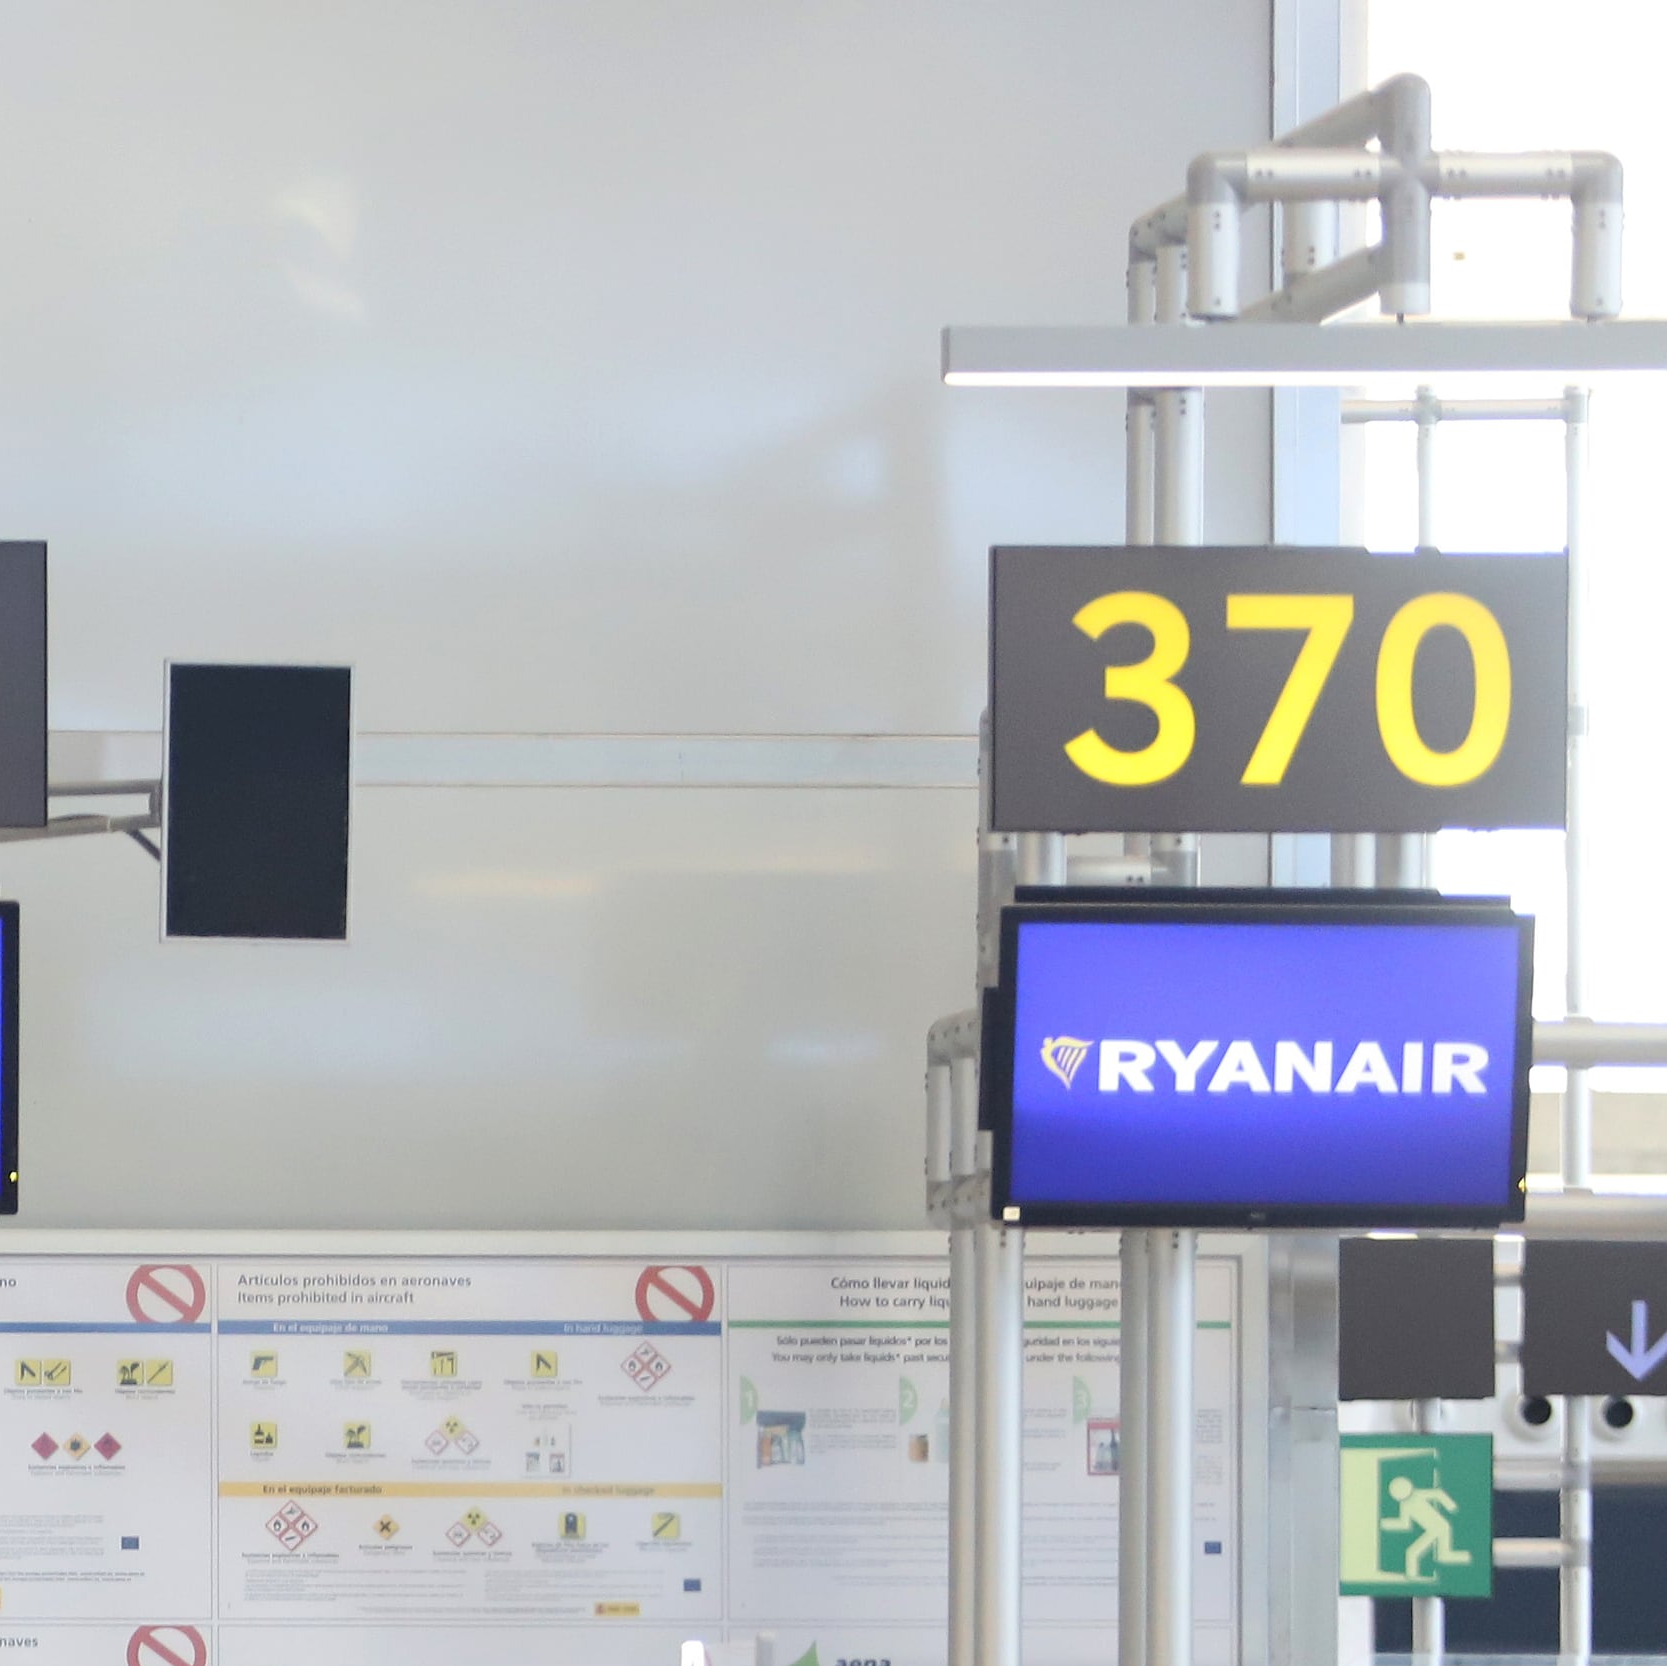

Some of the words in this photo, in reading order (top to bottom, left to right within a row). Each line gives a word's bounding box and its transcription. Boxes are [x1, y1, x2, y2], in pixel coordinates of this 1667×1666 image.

[1064, 591, 1512, 787] 370
[1099, 1040, 1489, 1093] RYANAIR
[303, 1274, 376, 1289] prohibidos
[381, 1277, 396, 1286] en
[402, 1278, 471, 1286] aeronaves
[238, 1292, 273, 1303] Items
[278, 1291, 346, 1306] prohibited
[351, 1292, 363, 1303] in
[368, 1291, 413, 1303] aircraft
[840, 1296, 871, 1307] How
[876, 1297, 889, 1307] to
[893, 1298, 925, 1310] carry
[1027, 1296, 1061, 1307] hand
[1065, 1296, 1118, 1310] luggage
